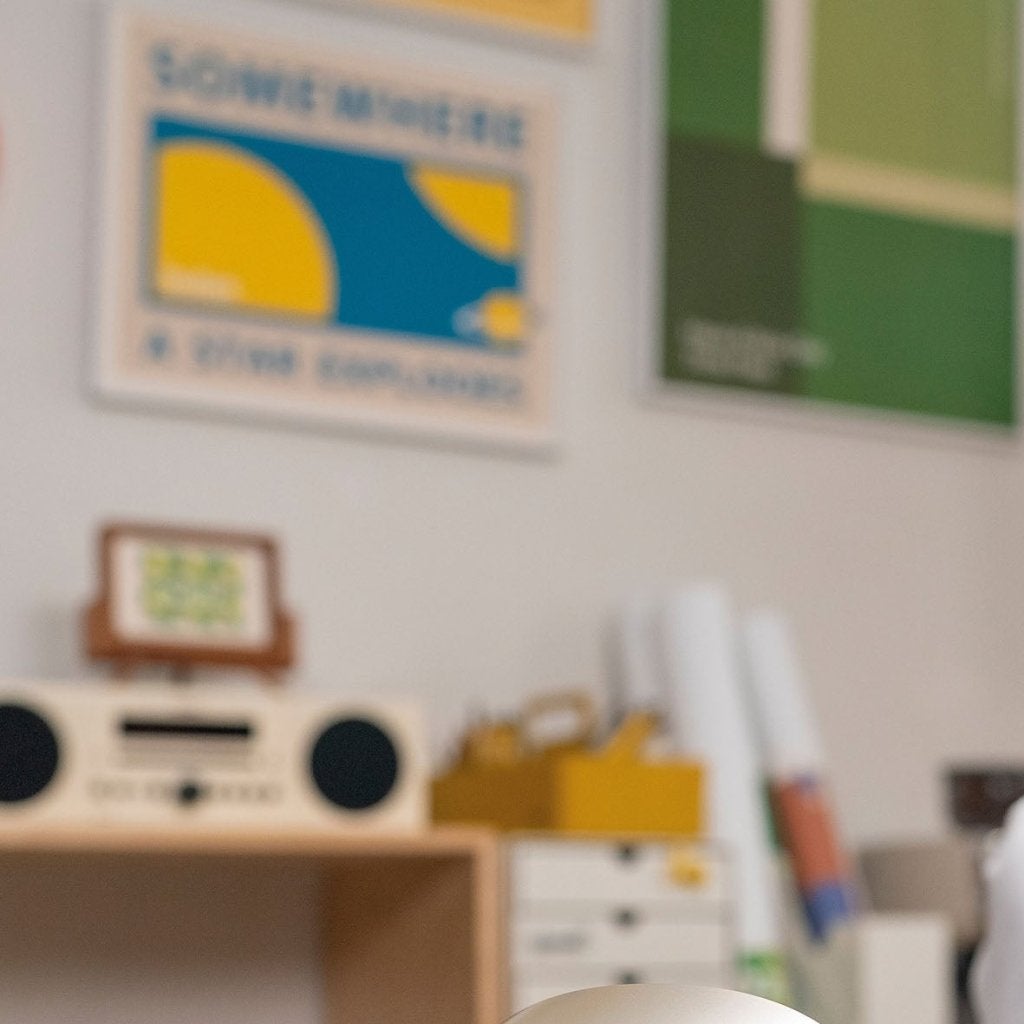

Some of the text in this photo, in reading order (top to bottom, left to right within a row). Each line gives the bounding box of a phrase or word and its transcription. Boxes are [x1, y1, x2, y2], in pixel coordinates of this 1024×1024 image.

[149, 44, 527, 152] SOMEWHERE
[144, 326, 173, 363] A
[191, 334, 300, 379] STAR
